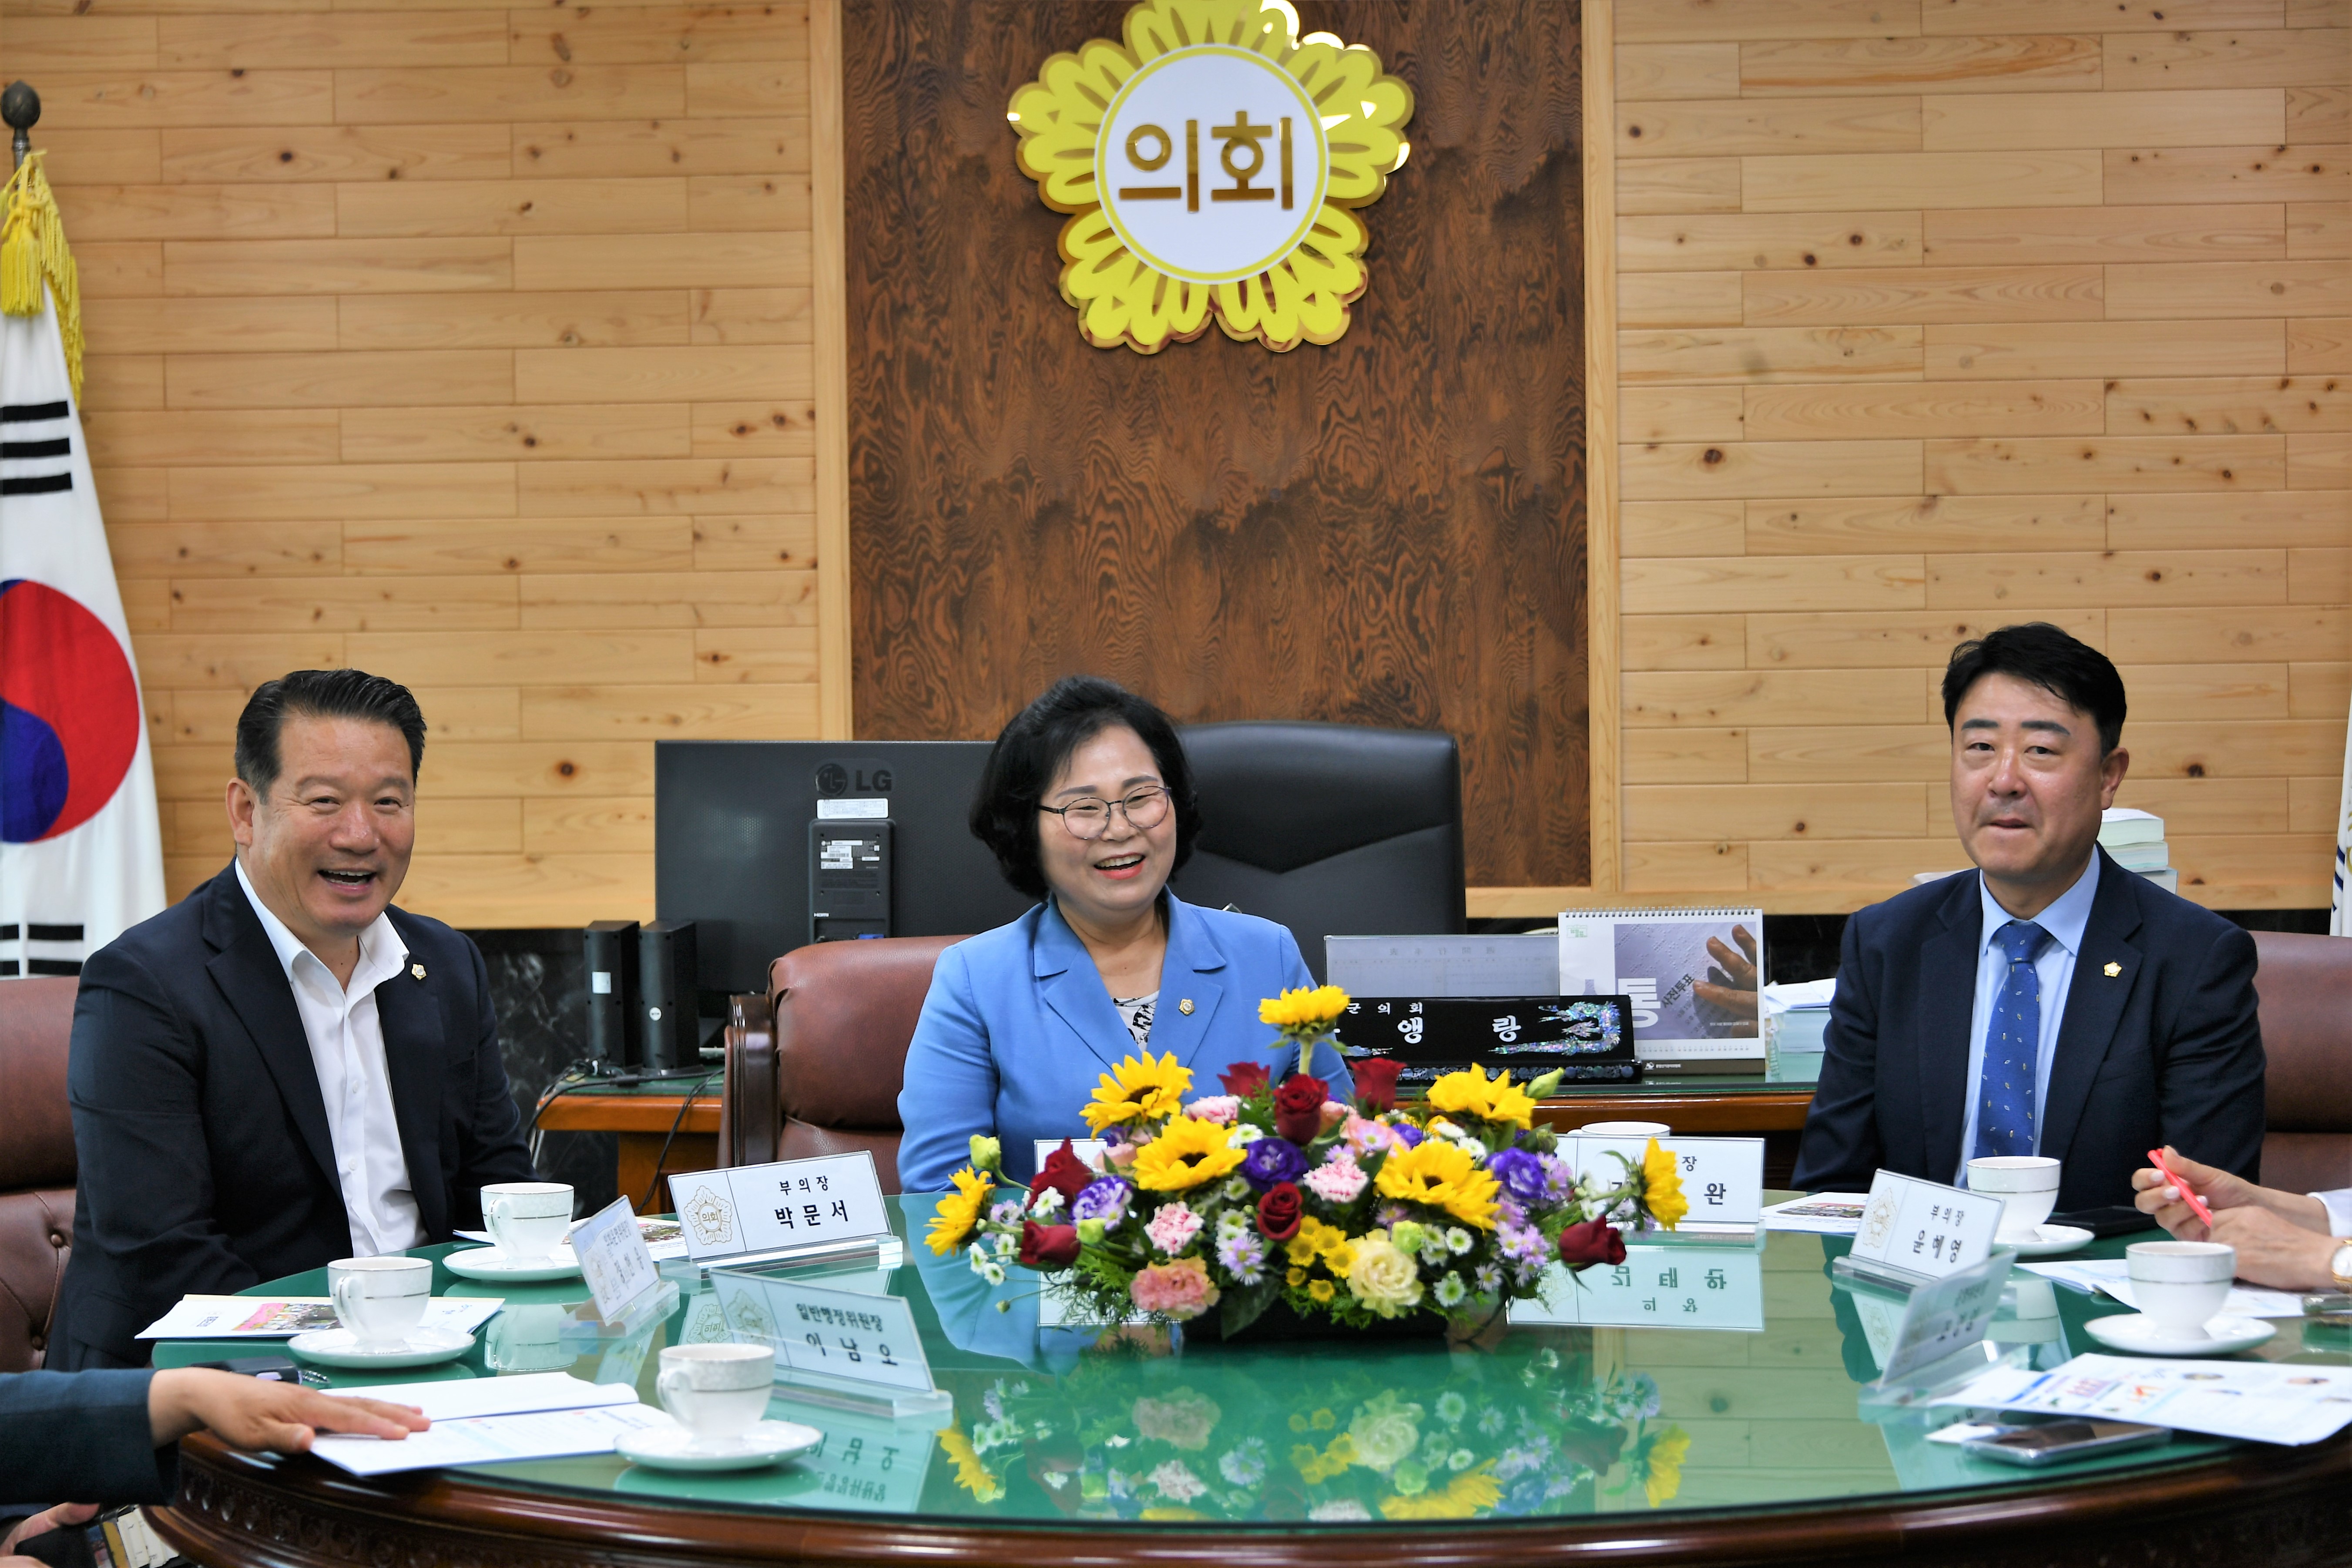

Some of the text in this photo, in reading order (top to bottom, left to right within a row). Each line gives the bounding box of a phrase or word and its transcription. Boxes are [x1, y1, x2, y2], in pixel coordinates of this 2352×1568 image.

[1118, 111, 1293, 213] 의회
[856, 769, 892, 792] LG
[1661, 973, 1695, 1008] 사전투표
[701, 1210, 720, 1224] 의회
[796, 1303, 883, 1332] 일반행정위원장
